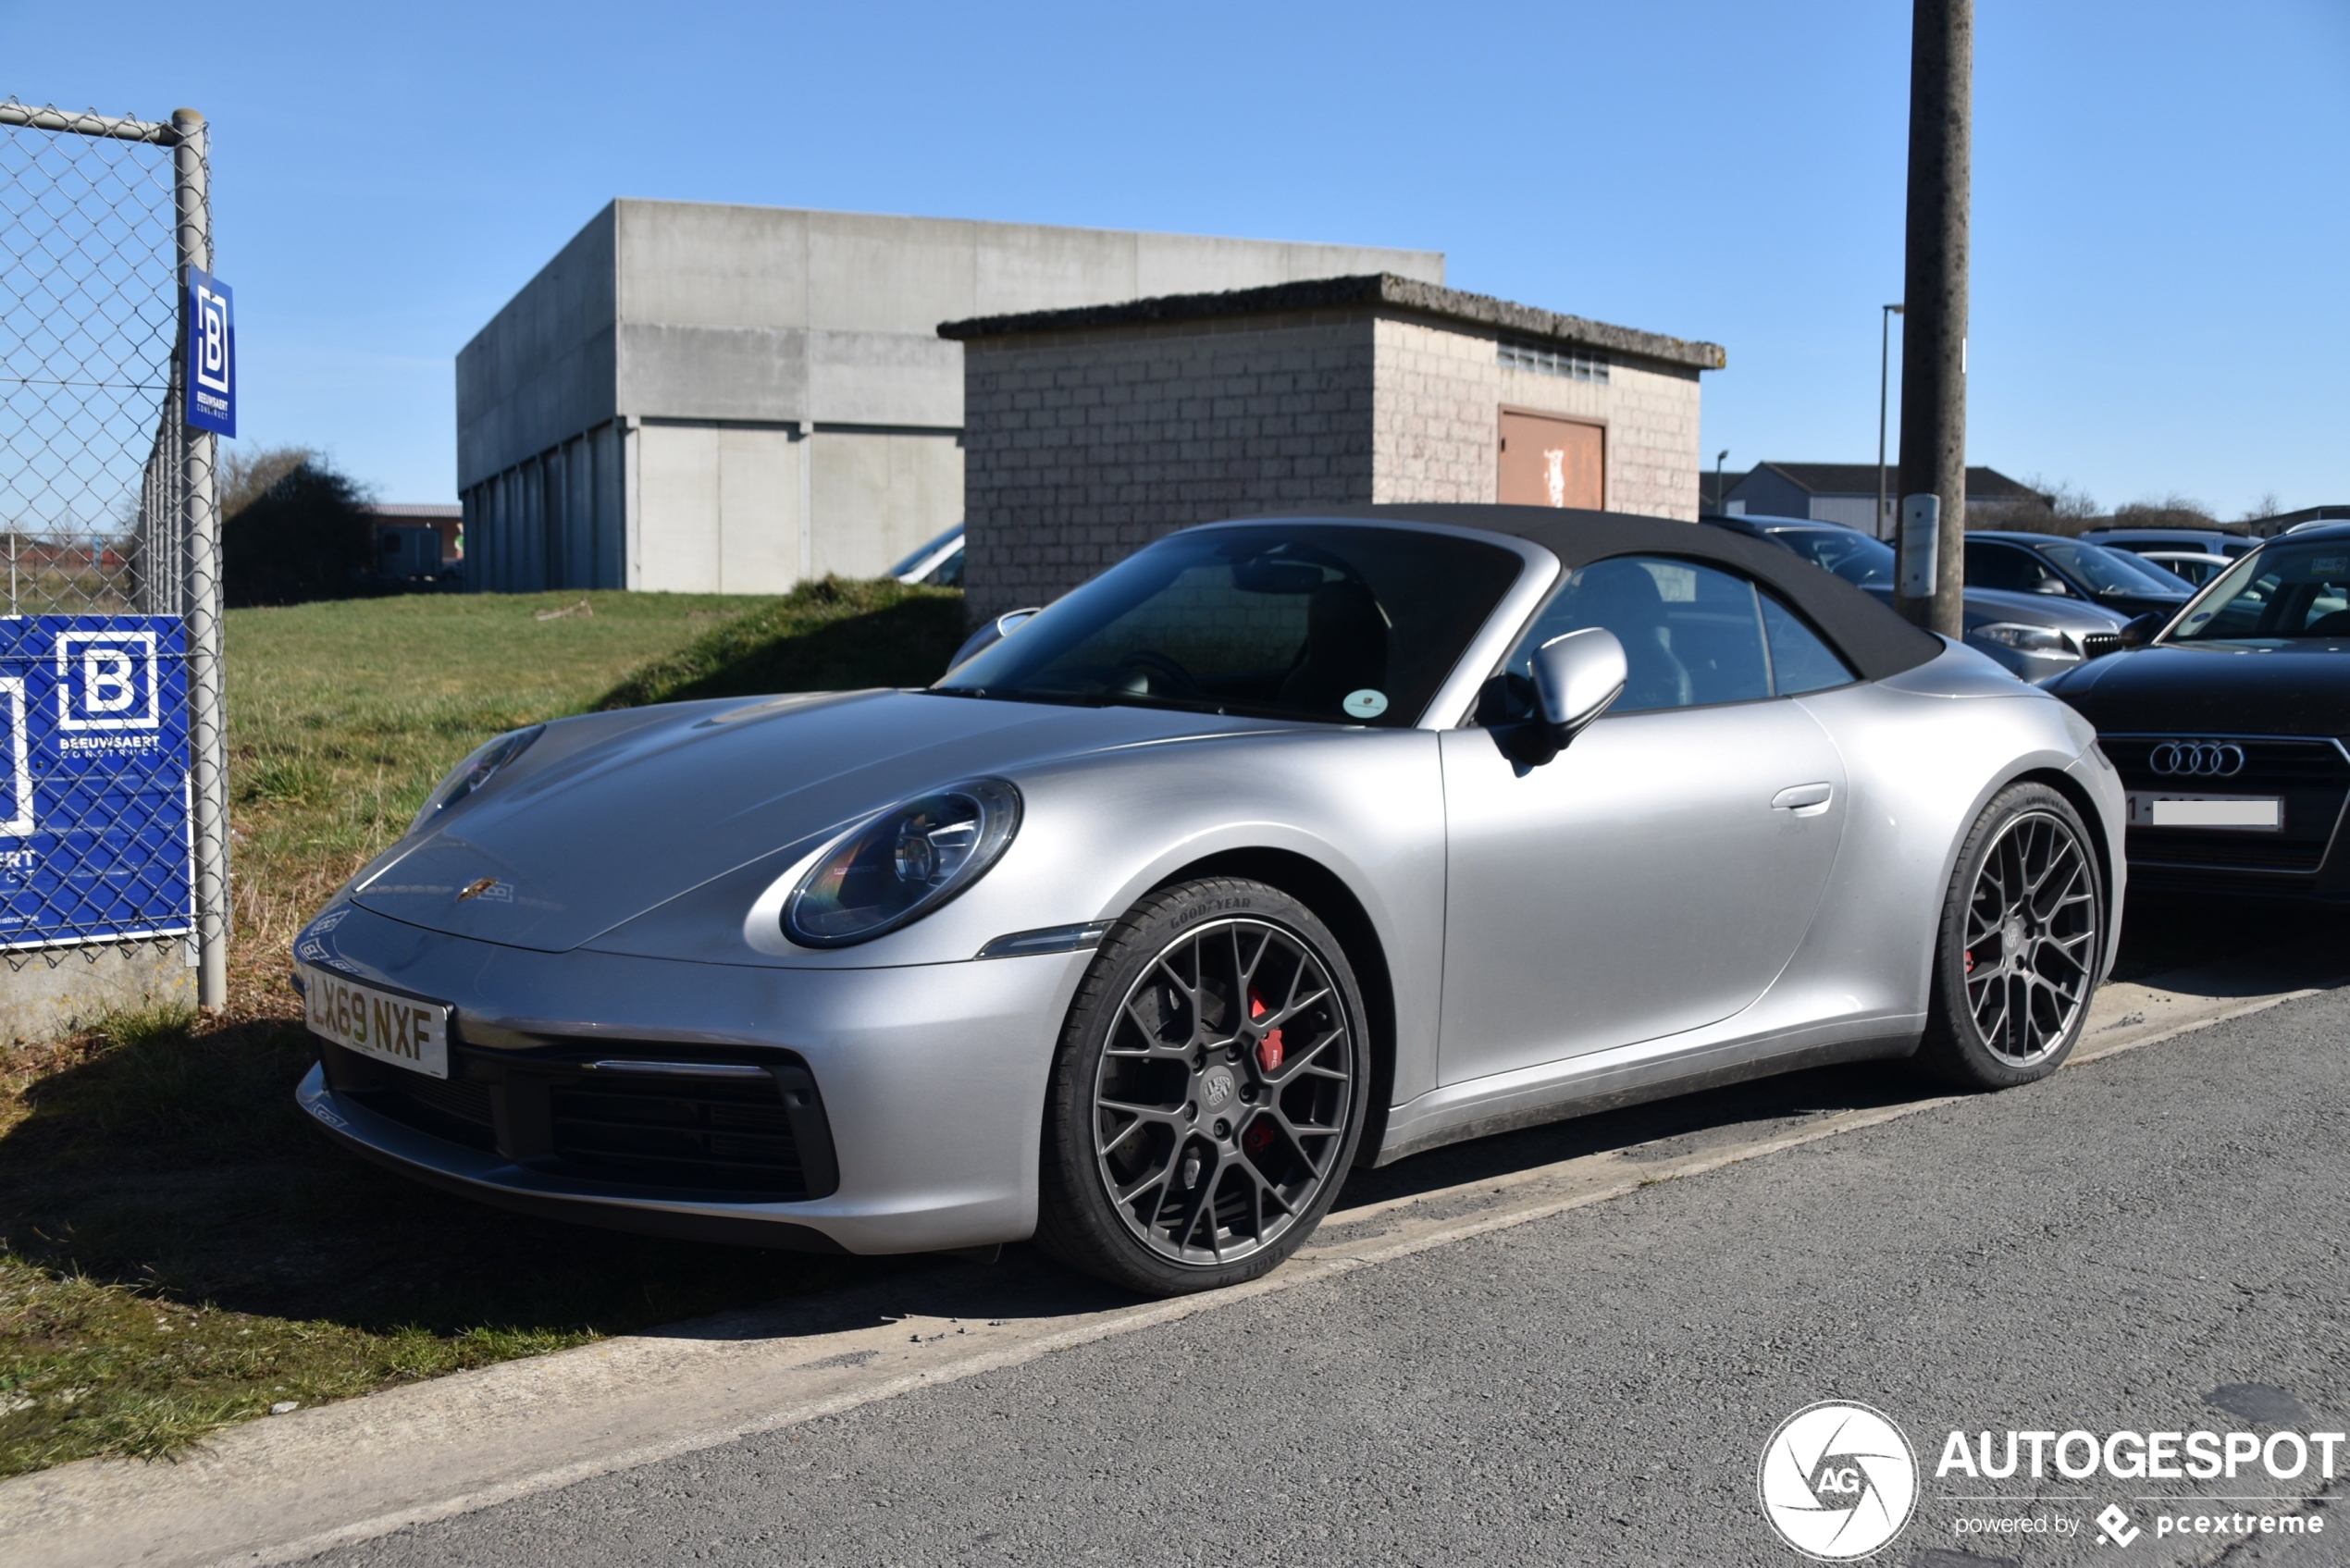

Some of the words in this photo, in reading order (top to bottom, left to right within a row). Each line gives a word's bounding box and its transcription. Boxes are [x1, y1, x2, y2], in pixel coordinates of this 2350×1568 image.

[205, 306, 222, 372] B
[83, 648, 135, 713] B
[60, 735, 160, 750] BEEUWSAERT
[310, 974, 368, 1043] LX69
[374, 997, 432, 1061] NXF
